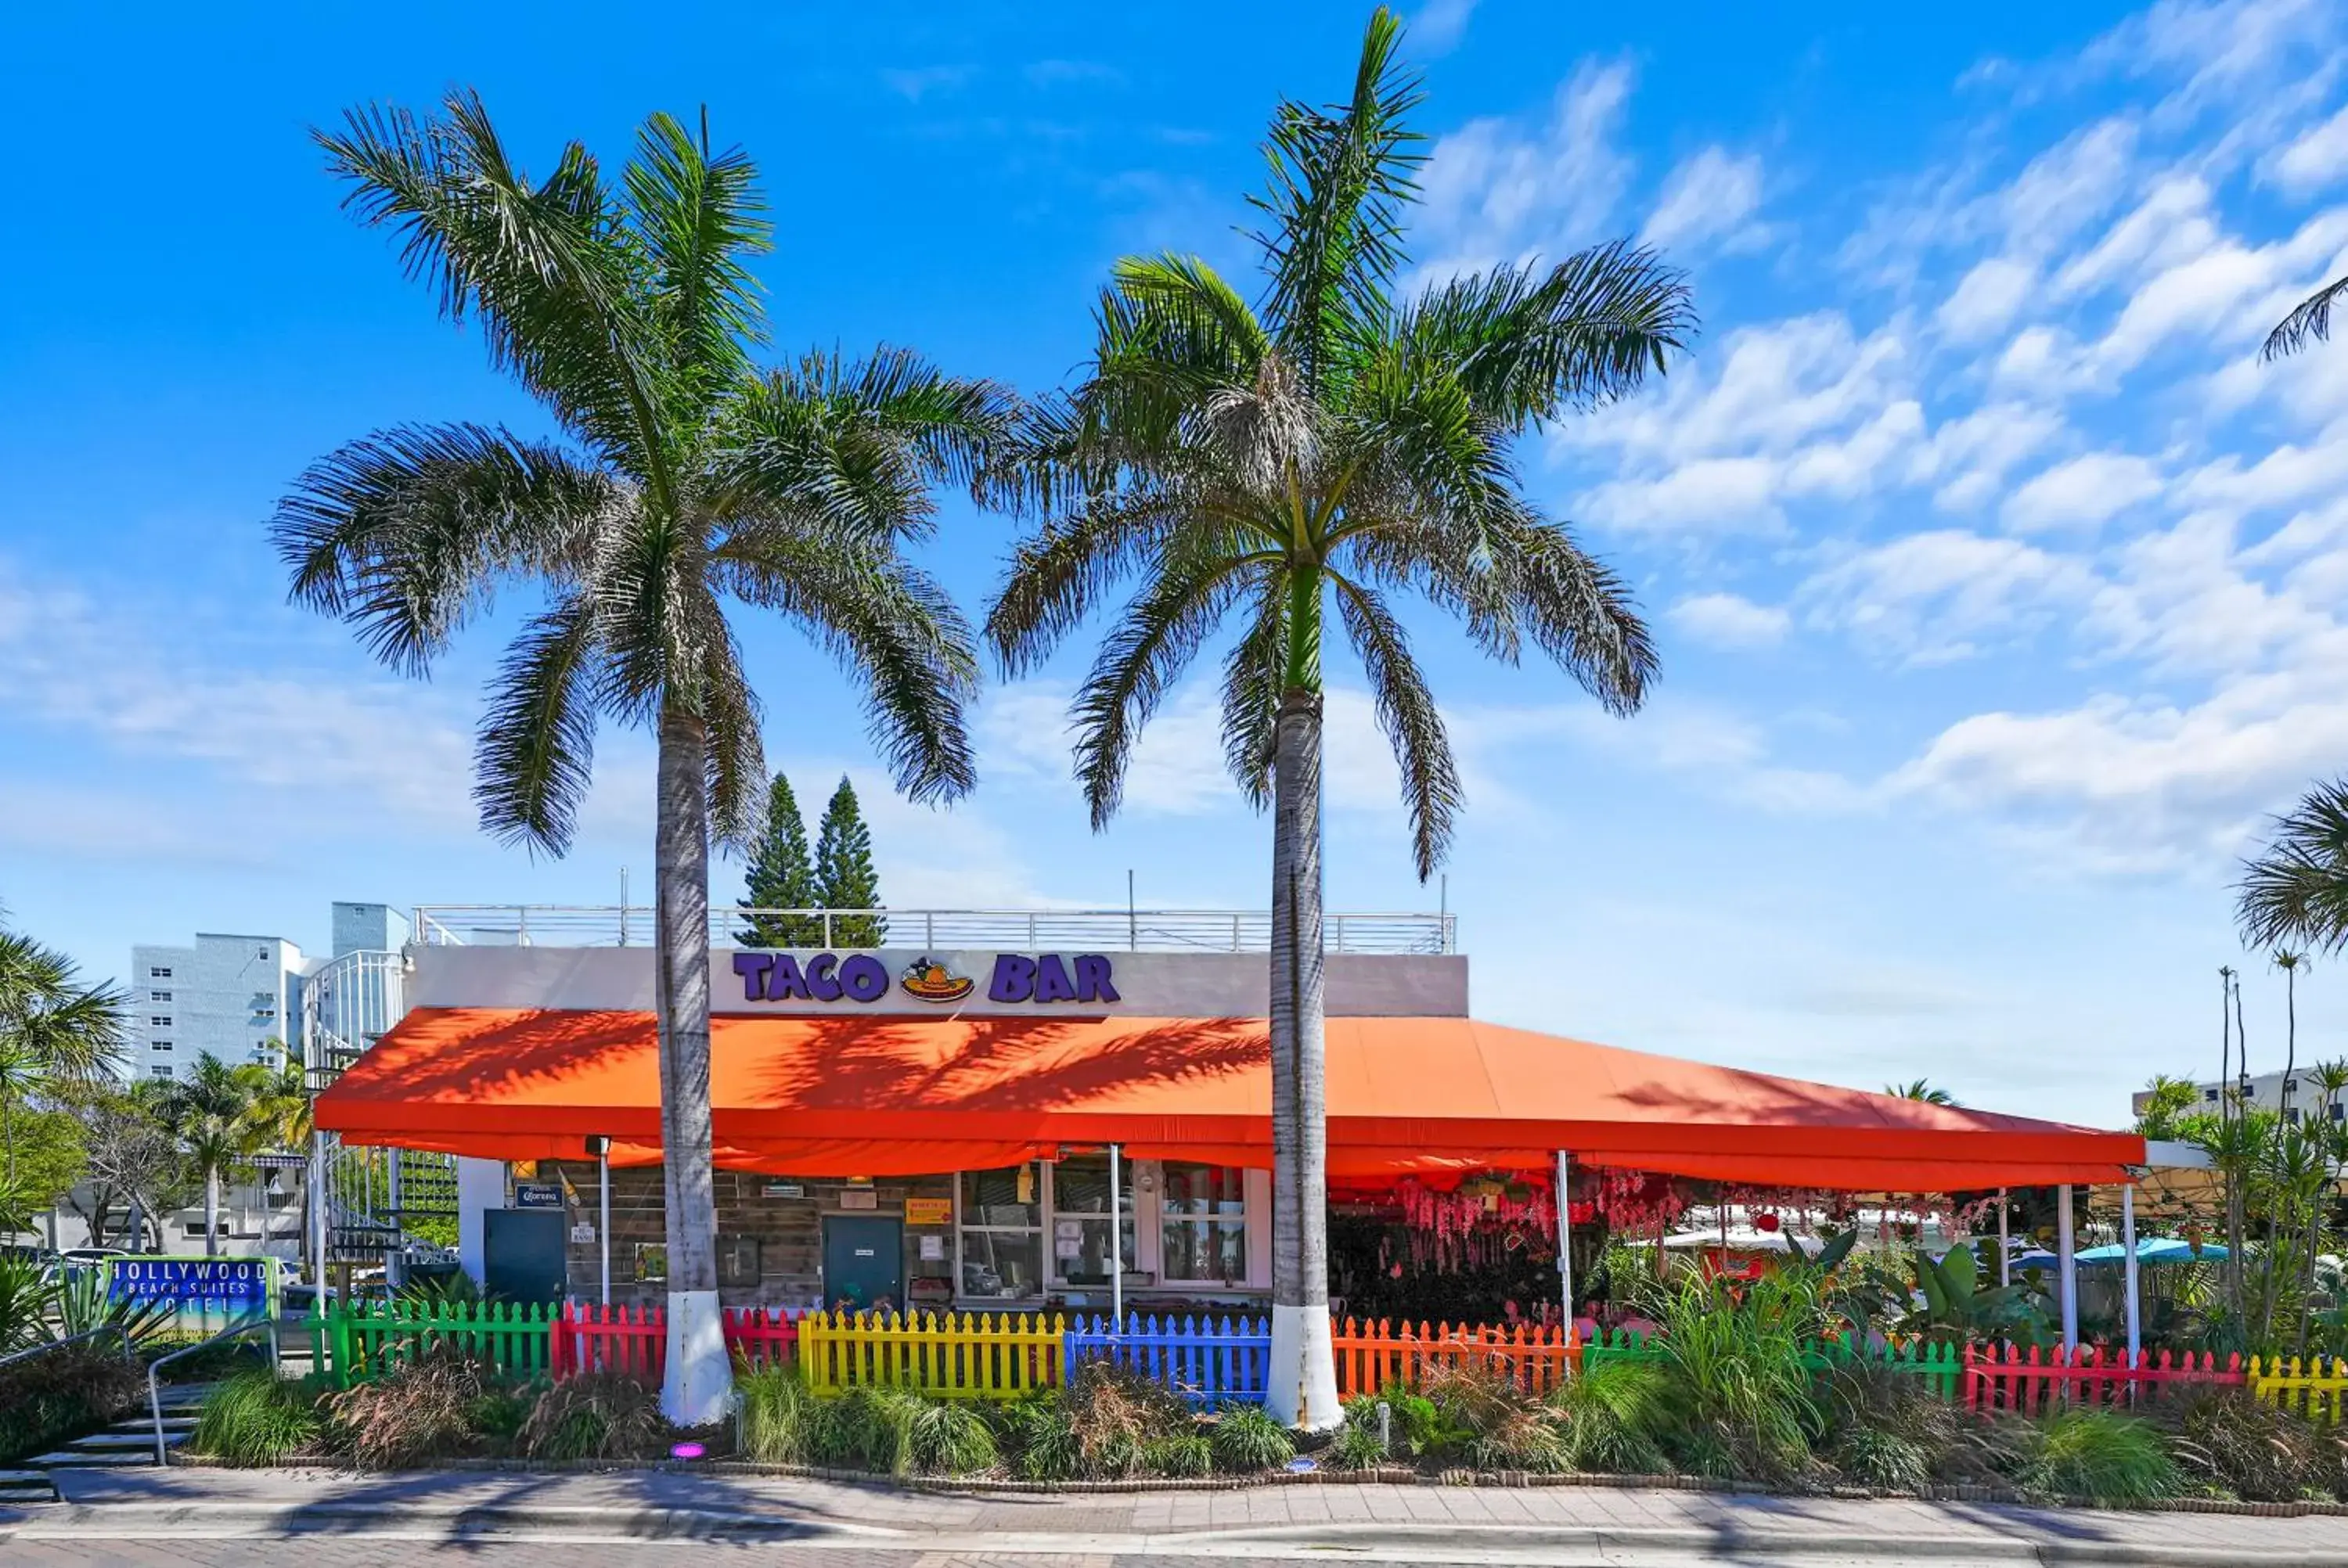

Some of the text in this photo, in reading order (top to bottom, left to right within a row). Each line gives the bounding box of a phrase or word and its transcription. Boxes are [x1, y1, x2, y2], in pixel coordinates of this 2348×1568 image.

[733, 952, 1121, 1003] TACO BAR
[524, 1191, 556, 1202] Corona
[128, 1282, 246, 1294] BEACH SUITES
